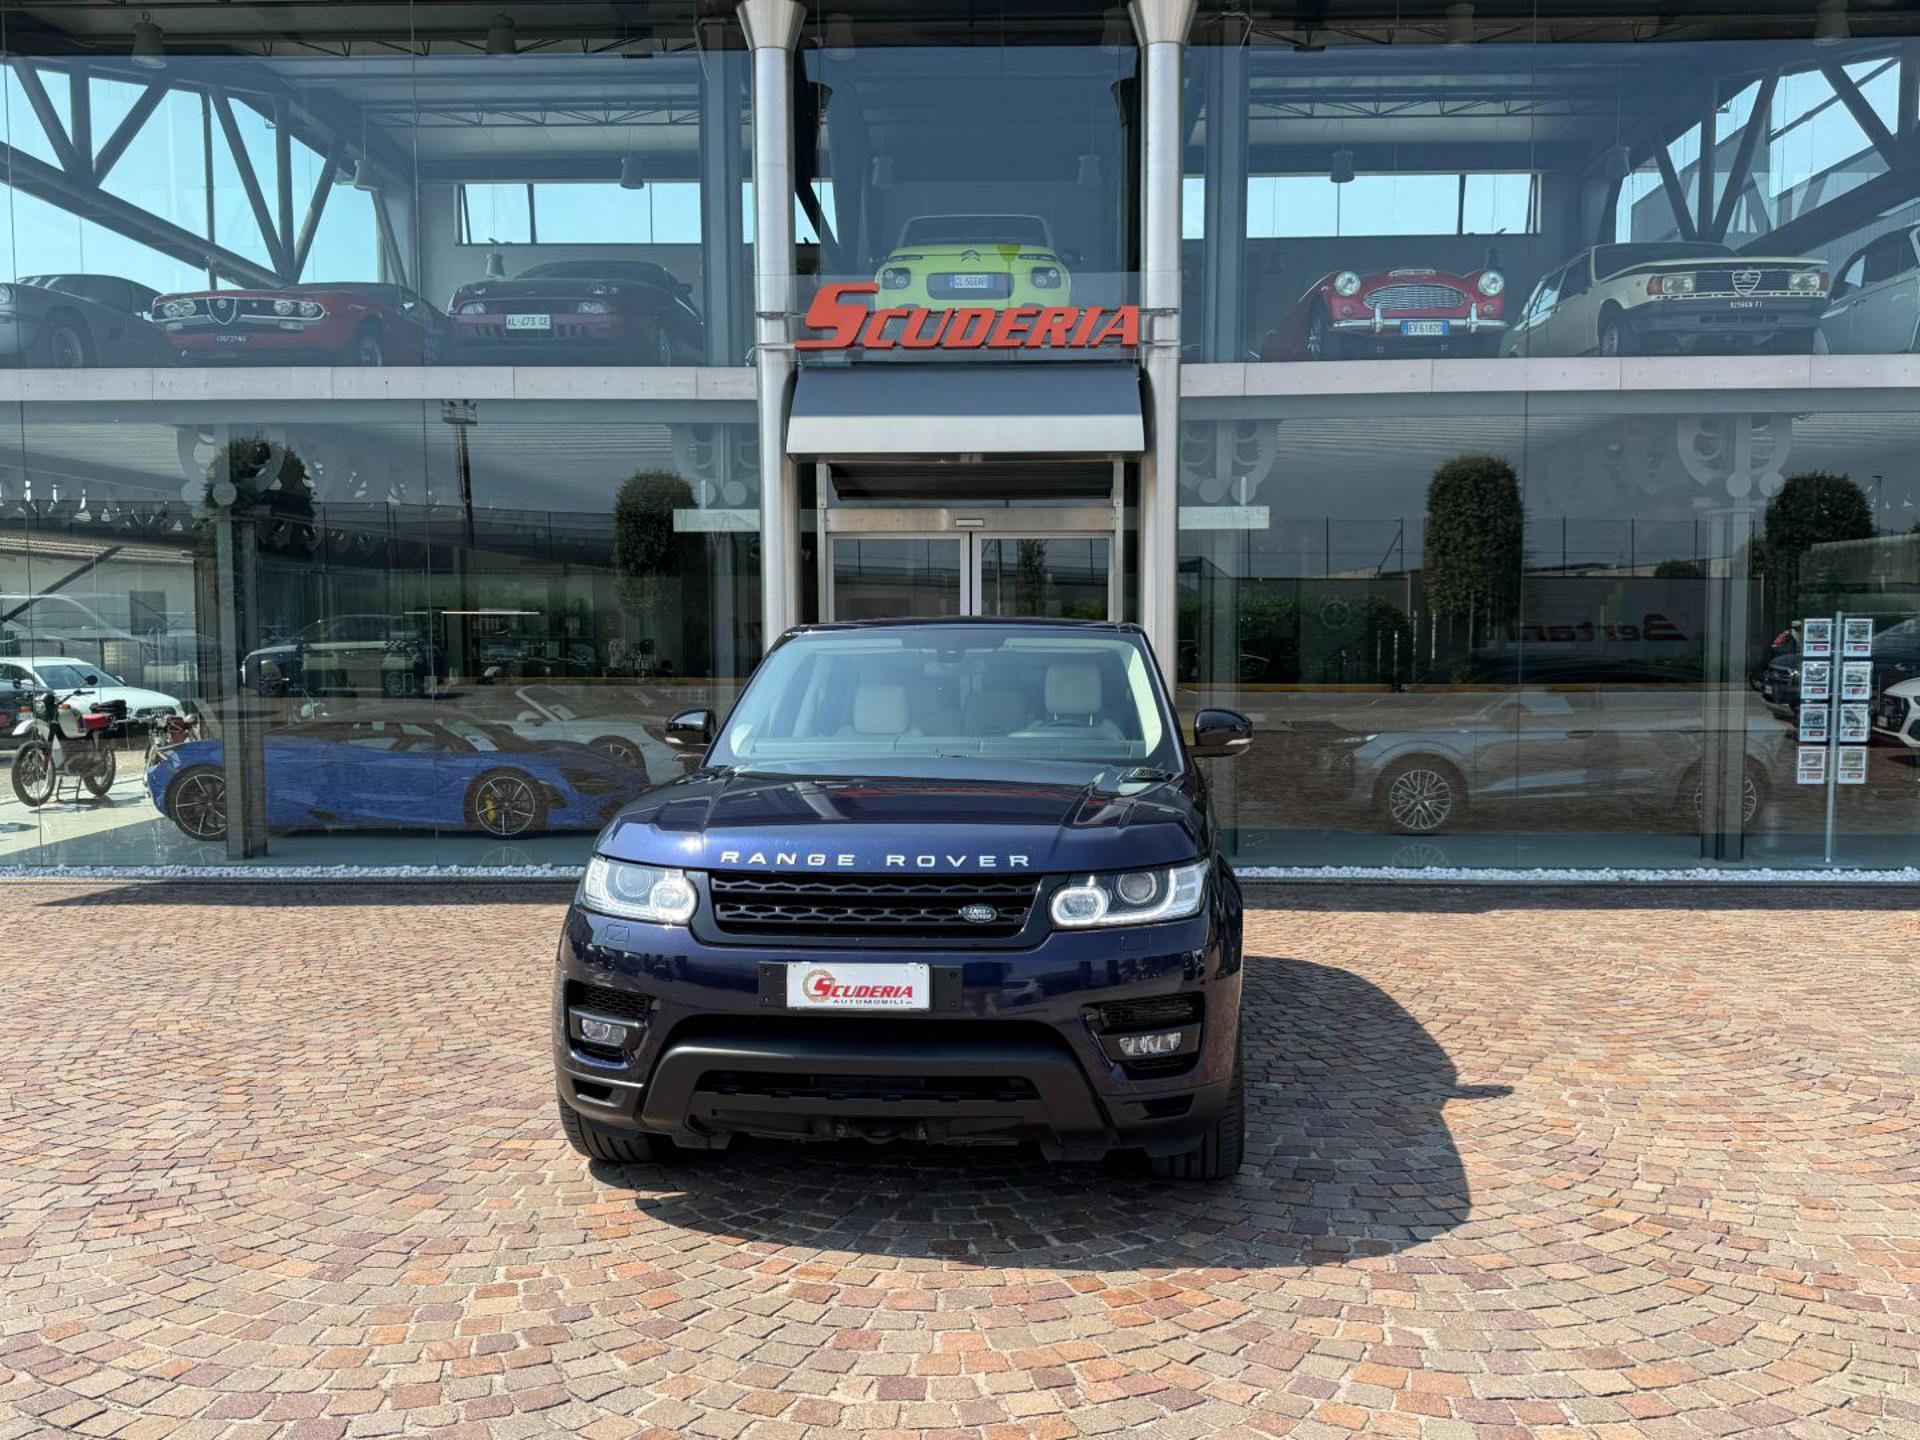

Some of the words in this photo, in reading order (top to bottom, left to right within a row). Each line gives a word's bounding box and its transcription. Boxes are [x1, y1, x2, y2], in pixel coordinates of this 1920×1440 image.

[795, 283, 1140, 349] SCUDERIA
[720, 851, 855, 866] RANGE
[886, 855, 1030, 867] ROVER
[810, 977, 913, 998] SCUDERIA
